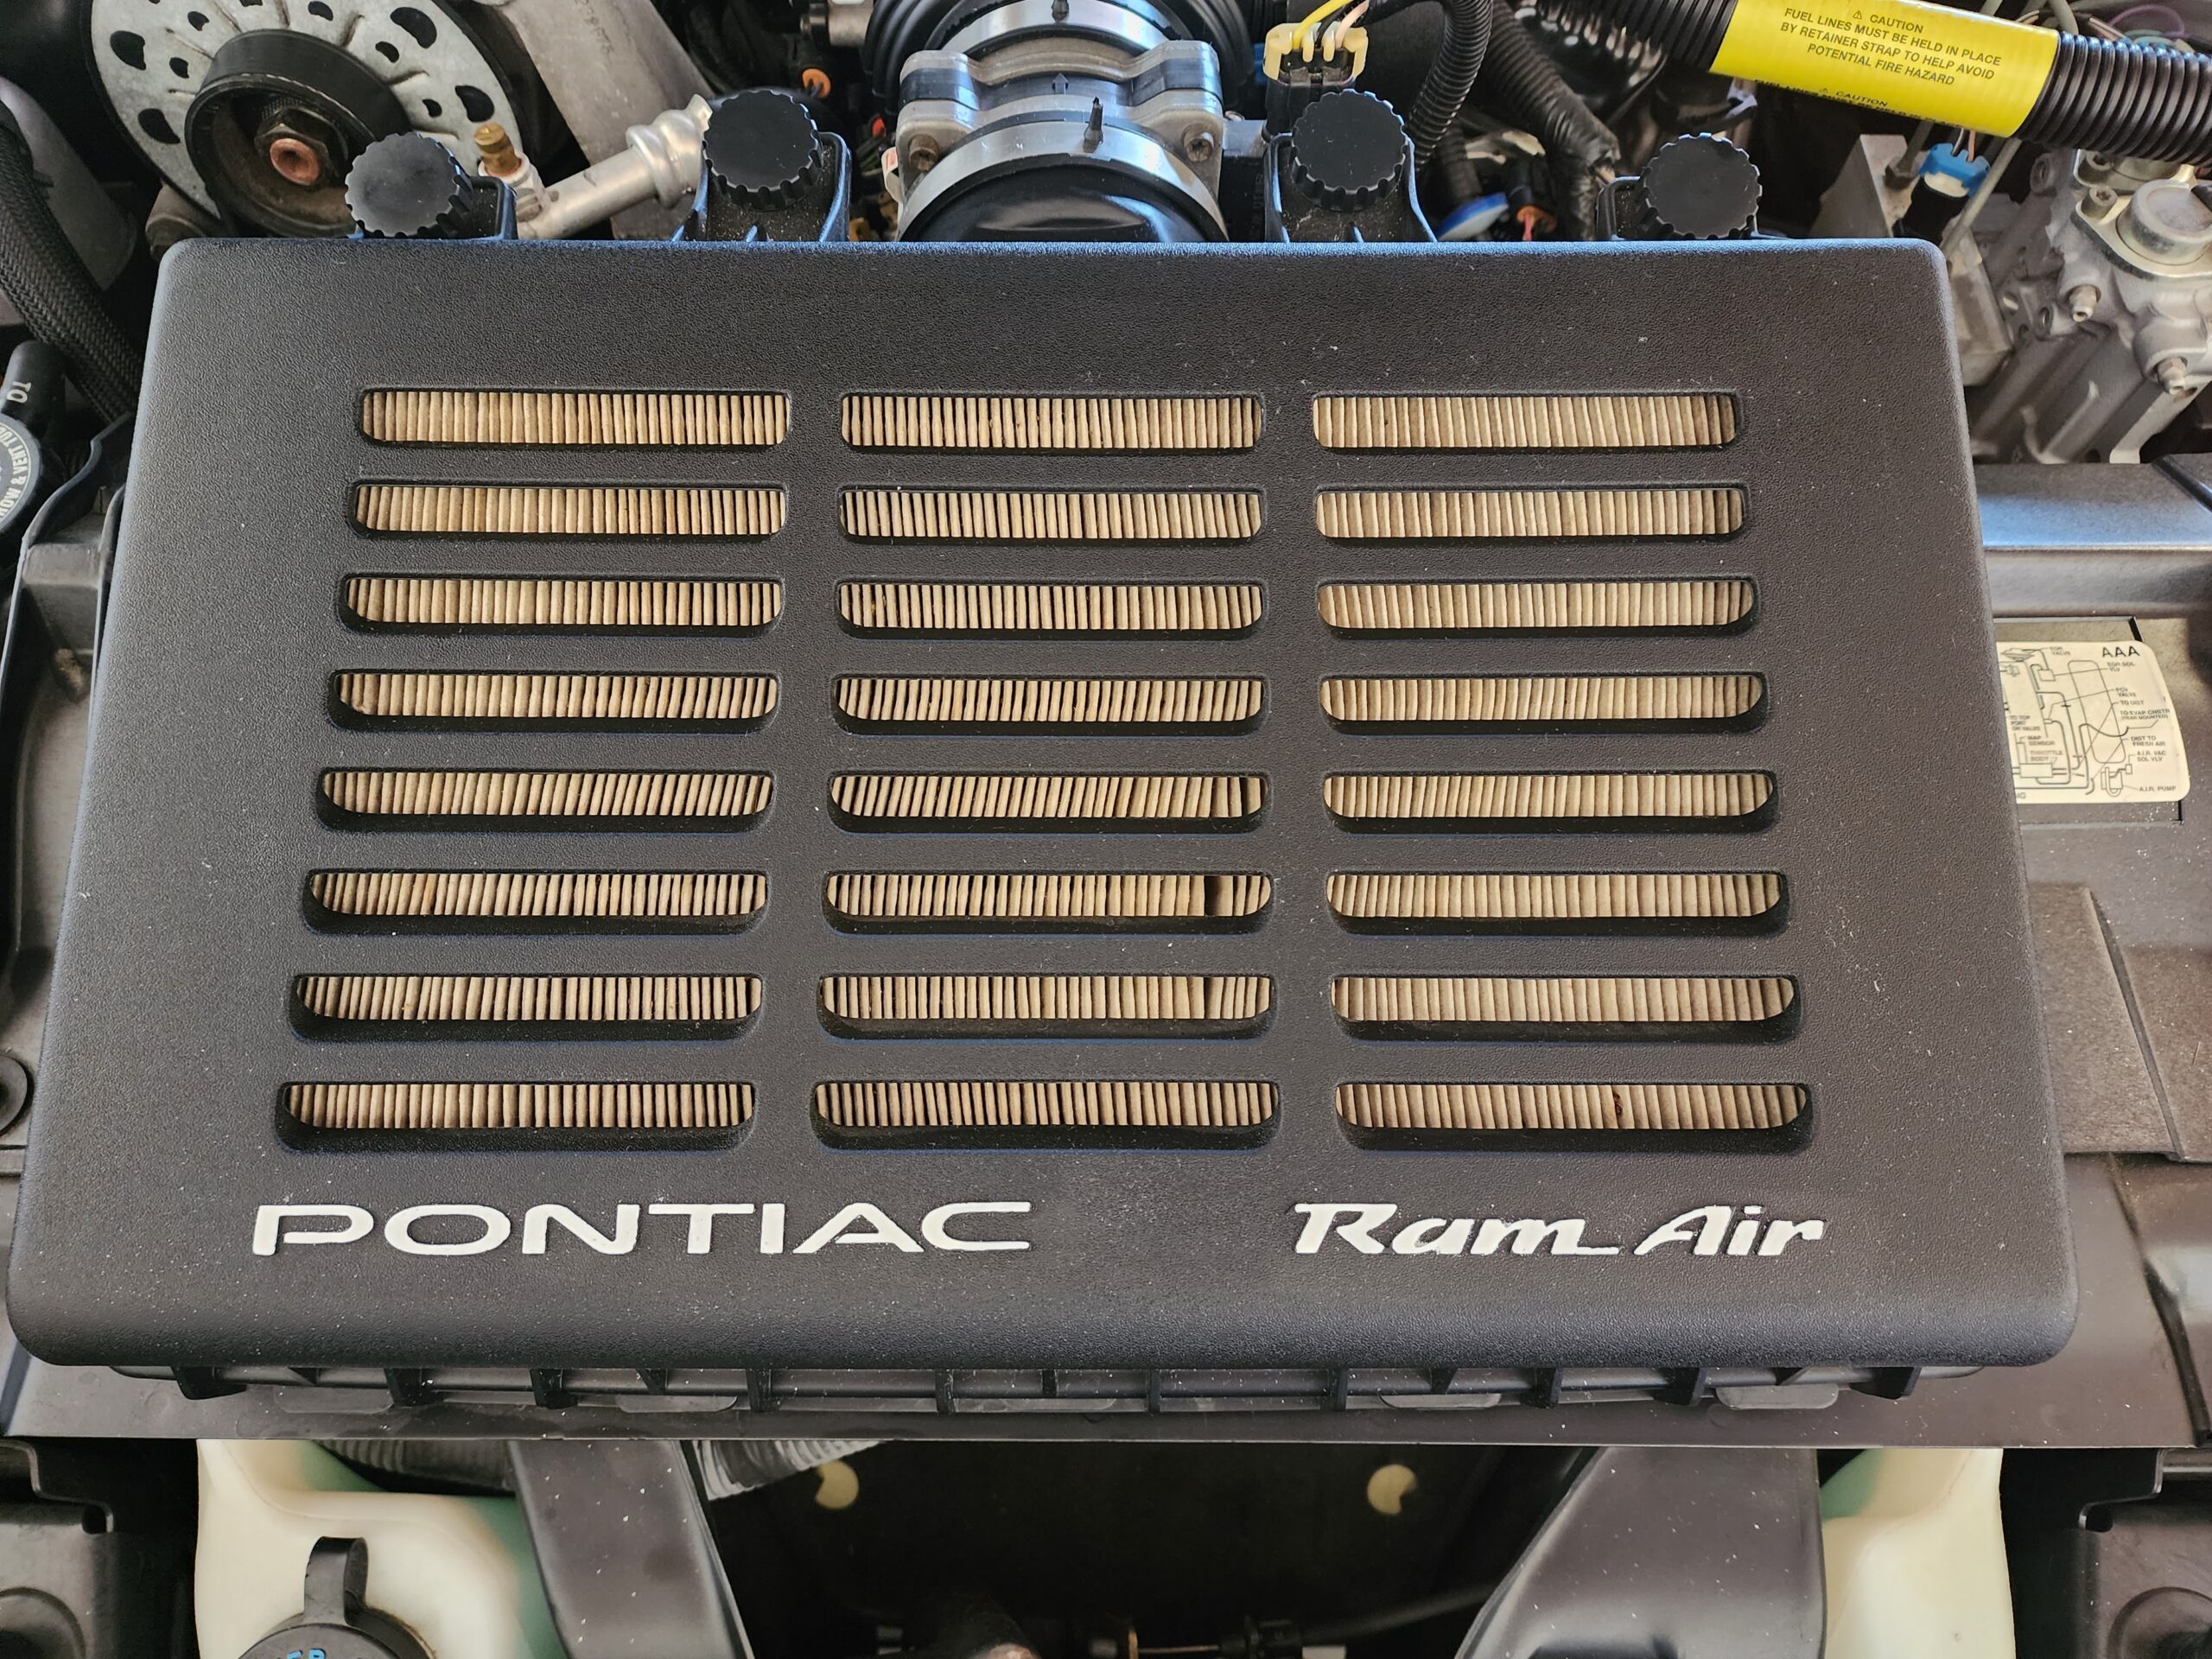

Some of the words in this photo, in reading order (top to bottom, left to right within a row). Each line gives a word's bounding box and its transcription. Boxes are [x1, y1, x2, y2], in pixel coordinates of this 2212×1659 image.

[1784, 7, 1814, 22] FUEL
[1817, 16, 1853, 31] LINES
[1854, 24, 1890, 40] MUST
[1891, 33, 1909, 45] BE
[1910, 36, 1943, 53] HELD
[1945, 45, 1959, 56] IN
[1961, 48, 2002, 66] PLACE
[1870, 14, 1923, 34] CAUTION
[1780, 22, 1798, 34] BY
[1799, 26, 1859, 48] RETAINER
[1861, 41, 1901, 58] STRAP
[1904, 50, 1919, 62] TO
[1923, 54, 1955, 70] HELP
[1956, 63, 1995, 79] AVOID
[1807, 43, 1872, 67] POTENTIAL
[1875, 59, 1904, 73] FIRE
[1904, 66, 1955, 86] HAZARD
[1835, 90, 1887, 107] CAUTION
[8, 444, 29, 475] VENT
[2102, 645, 2141, 658] AAA
[252, 1202, 1033, 1256] PONTIAC
[1294, 1203, 1619, 1255] Ram
[1634, 1205, 1825, 1255] Air
